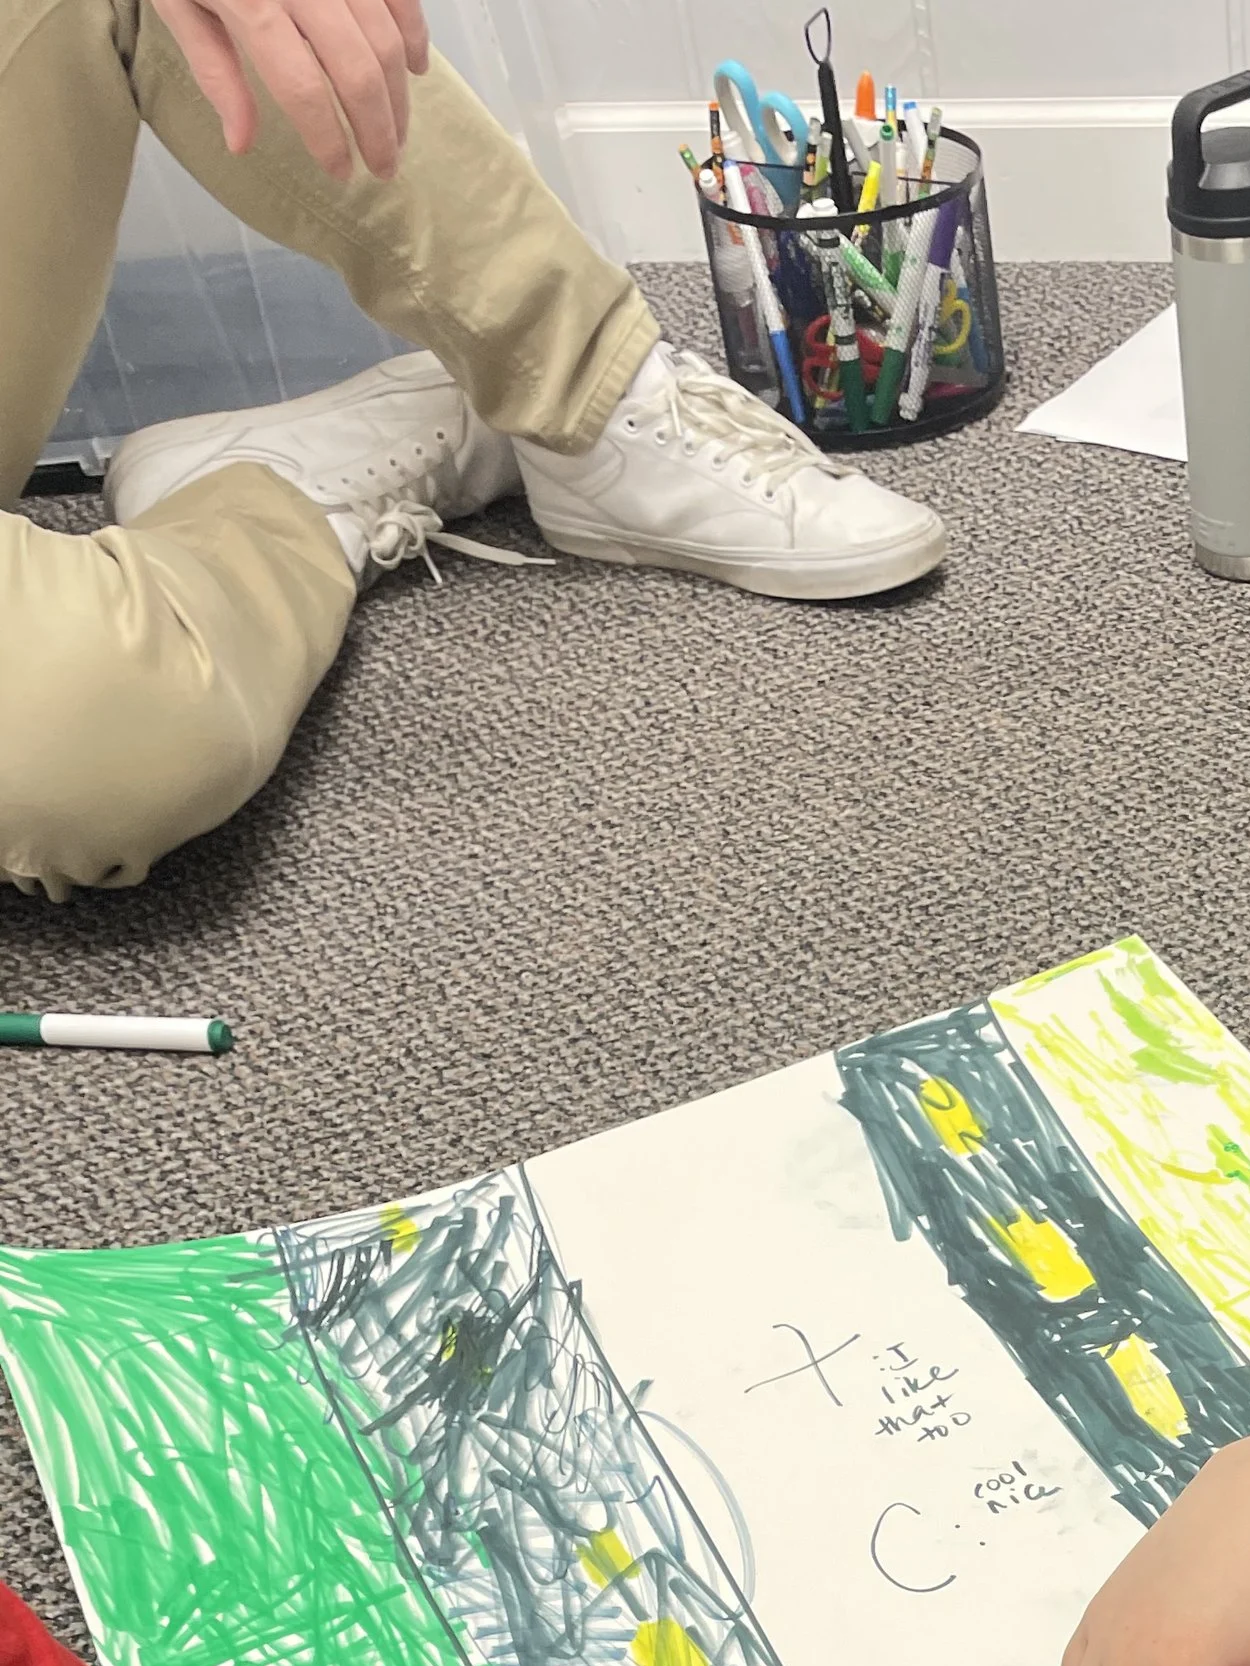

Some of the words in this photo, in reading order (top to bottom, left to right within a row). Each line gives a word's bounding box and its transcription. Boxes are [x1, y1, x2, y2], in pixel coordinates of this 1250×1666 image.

[881, 1366, 959, 1404] like
[875, 1393, 954, 1436] that
[917, 1412, 971, 1442] too
[974, 1461, 1027, 1498] cool
